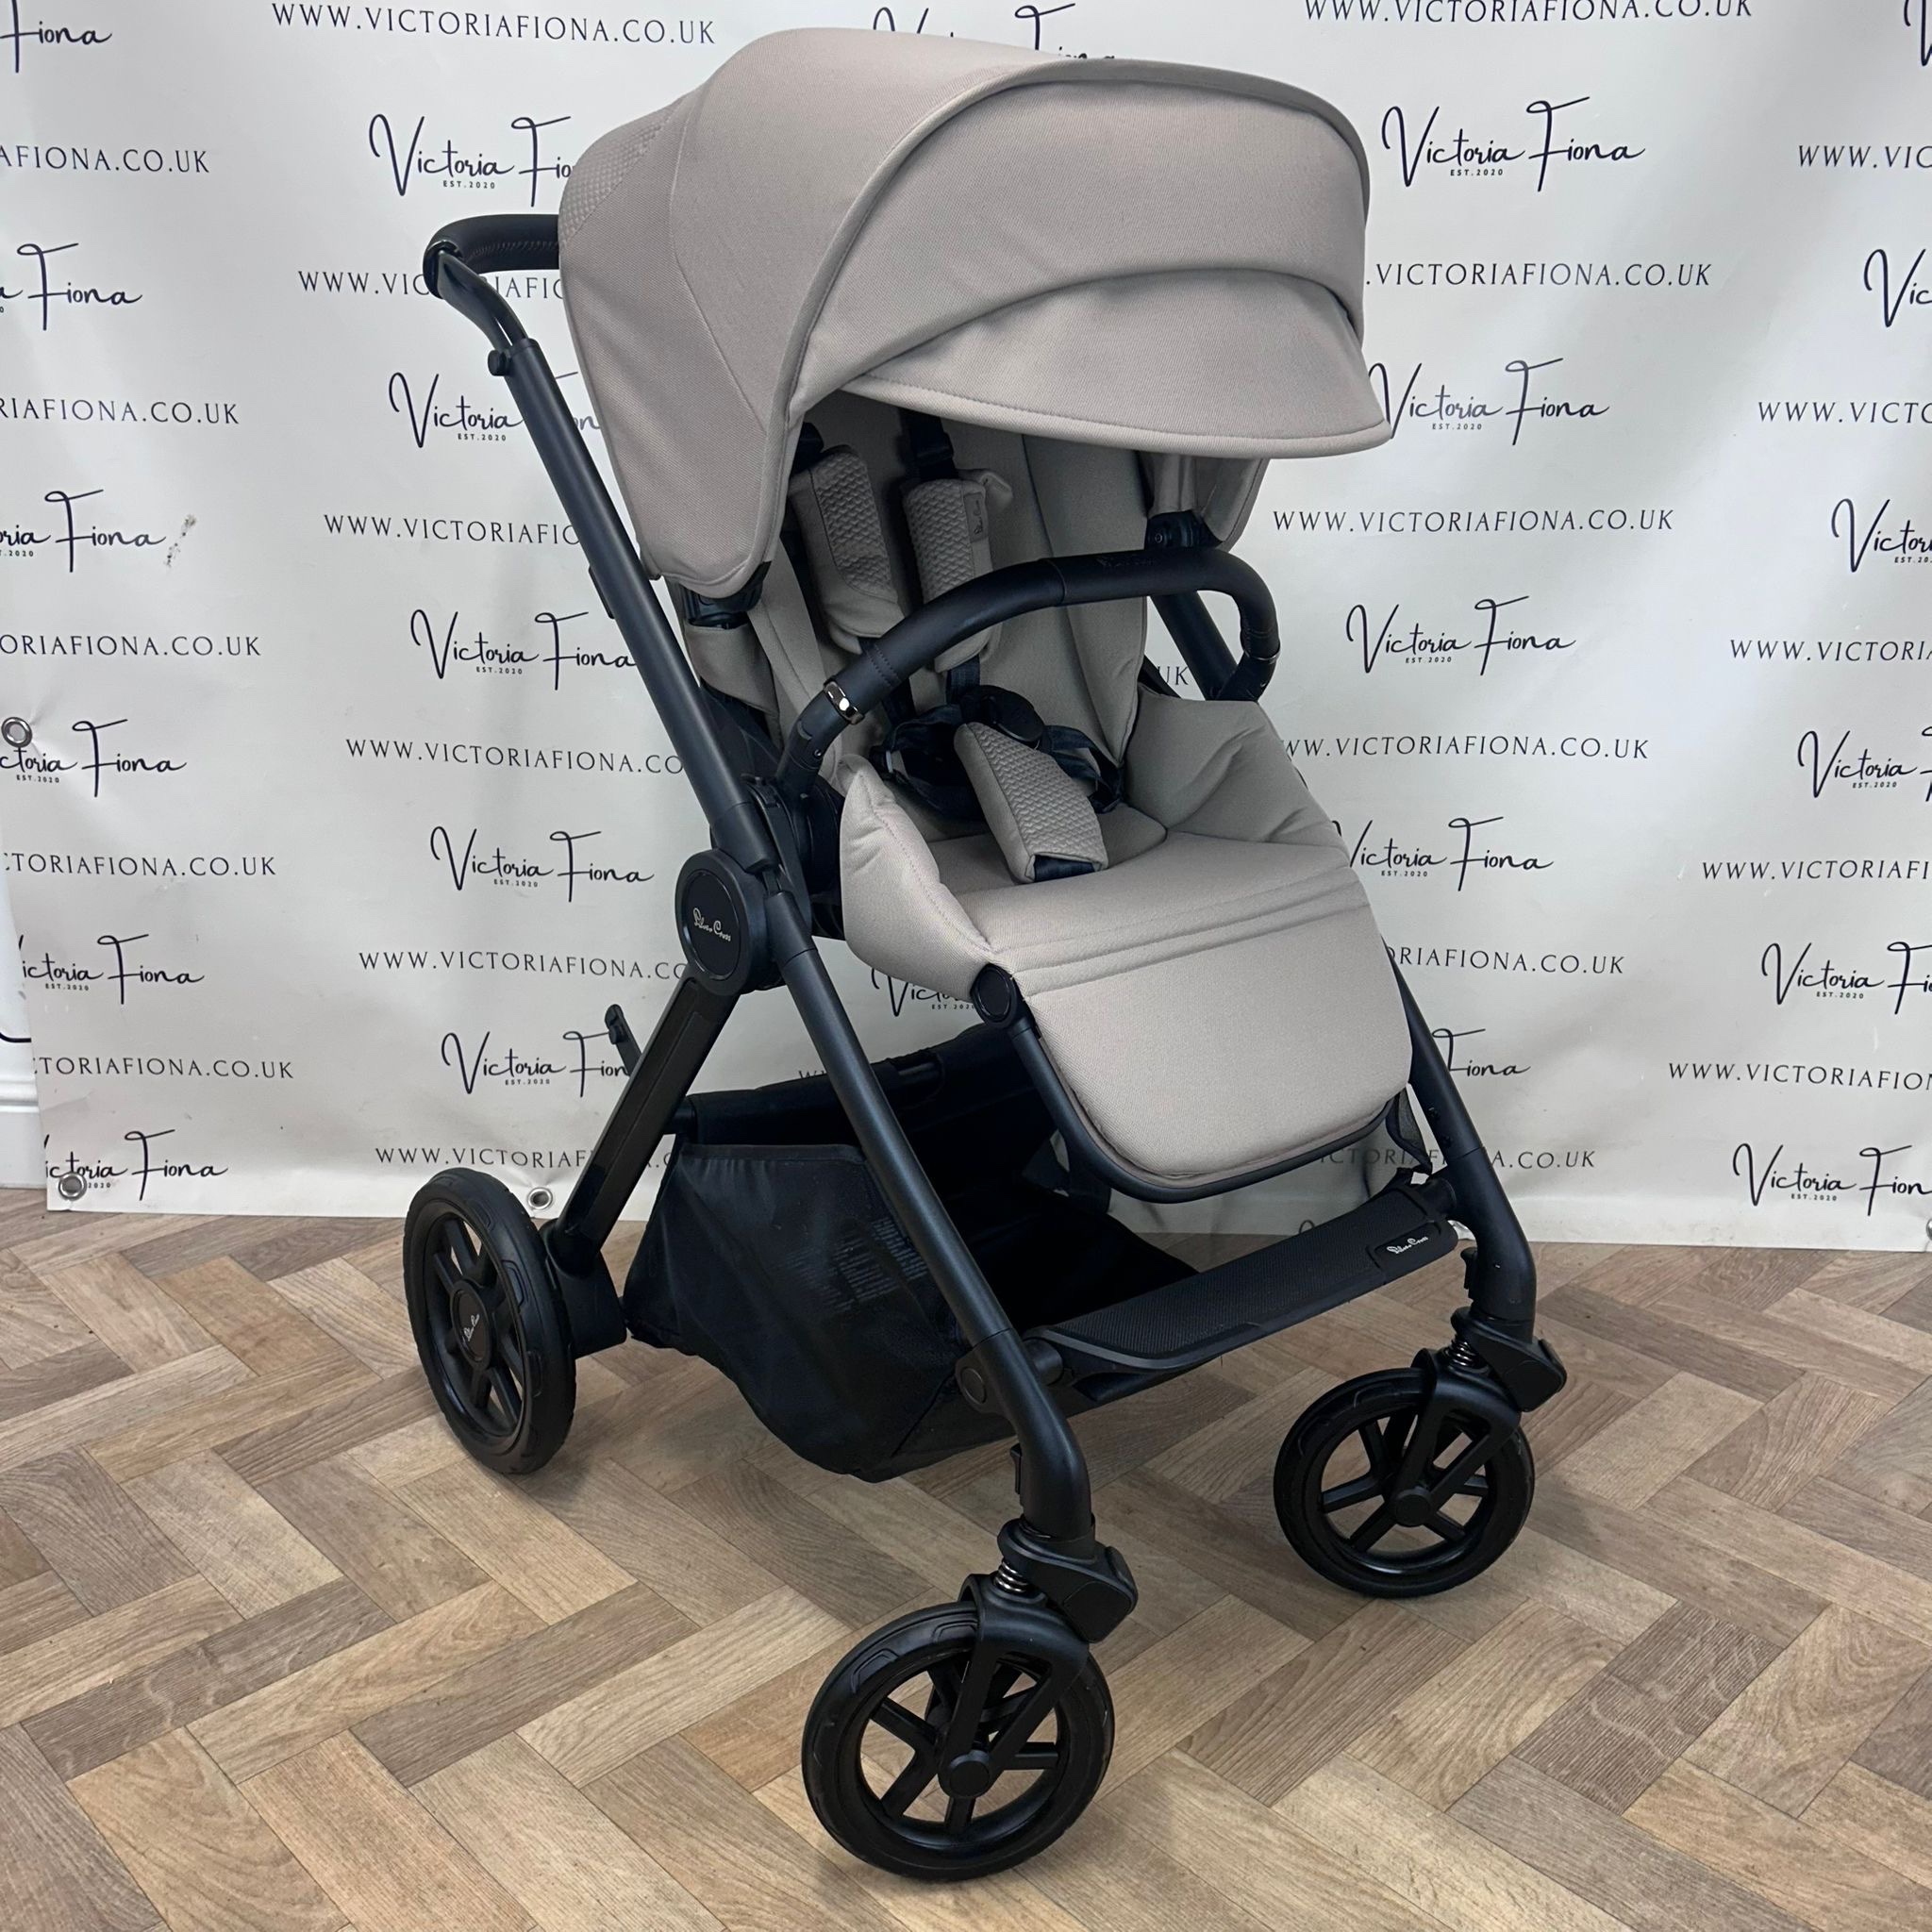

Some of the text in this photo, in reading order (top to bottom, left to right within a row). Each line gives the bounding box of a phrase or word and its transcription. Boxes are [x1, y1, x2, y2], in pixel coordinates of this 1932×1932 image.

[271, 2, 715, 44] WWW.VICTORIAFIONA.CO.UK
[1305, 0, 1752, 23] WWW.VICTORIAFIONA.CO.UK
[368, 113, 515, 197] Victoria
[1380, 95, 1646, 193] Victoria Fiona
[442, 179, 495, 190] EST.2020
[1449, 168, 1504, 177] EST.2020
[16, 242, 143, 332] Fiona
[388, 372, 525, 449] Victoria
[1431, 423, 1482, 431] EST.2020
[1504, 357, 1610, 446] Fiona
[457, 432, 507, 442] EST.2020
[43, 489, 167, 574] Fiona
[1273, 508, 1674, 533] WWW.VICTORIAFIONA.CO.UK
[409, 608, 637, 692] Victoria Fiona
[1345, 595, 1577, 676] Victoria Fiona
[1405, 656, 1452, 664] EST.2020
[475, 665, 523, 675] EST.2020
[15, 774, 60, 784] EST.2020
[71, 718, 188, 798] Fiona
[1796, 729, 1919, 799] Victoria
[1852, 780, 1897, 790] EST.2020
[3, 852, 276, 876] TORIAFIONA.CO.UK
[429, 825, 656, 904] Victoria Fiona
[1447, 815, 1555, 892] Fiona
[493, 878, 539, 888] EST.2020
[44, 982, 90, 991] EST.2020
[96, 933, 206, 1006] Fiona
[1760, 941, 1886, 1006] Victoria
[1816, 991, 1864, 1000] EST.2020
[32, 1057, 294, 1079] TORIAFIONA.CO.UK
[441, 1030, 567, 1095] Victoria
[124, 1128, 229, 1202] Fiona
[1732, 1142, 1857, 1208] Victoria
[1790, 1192, 1838, 1202] EST.2020
